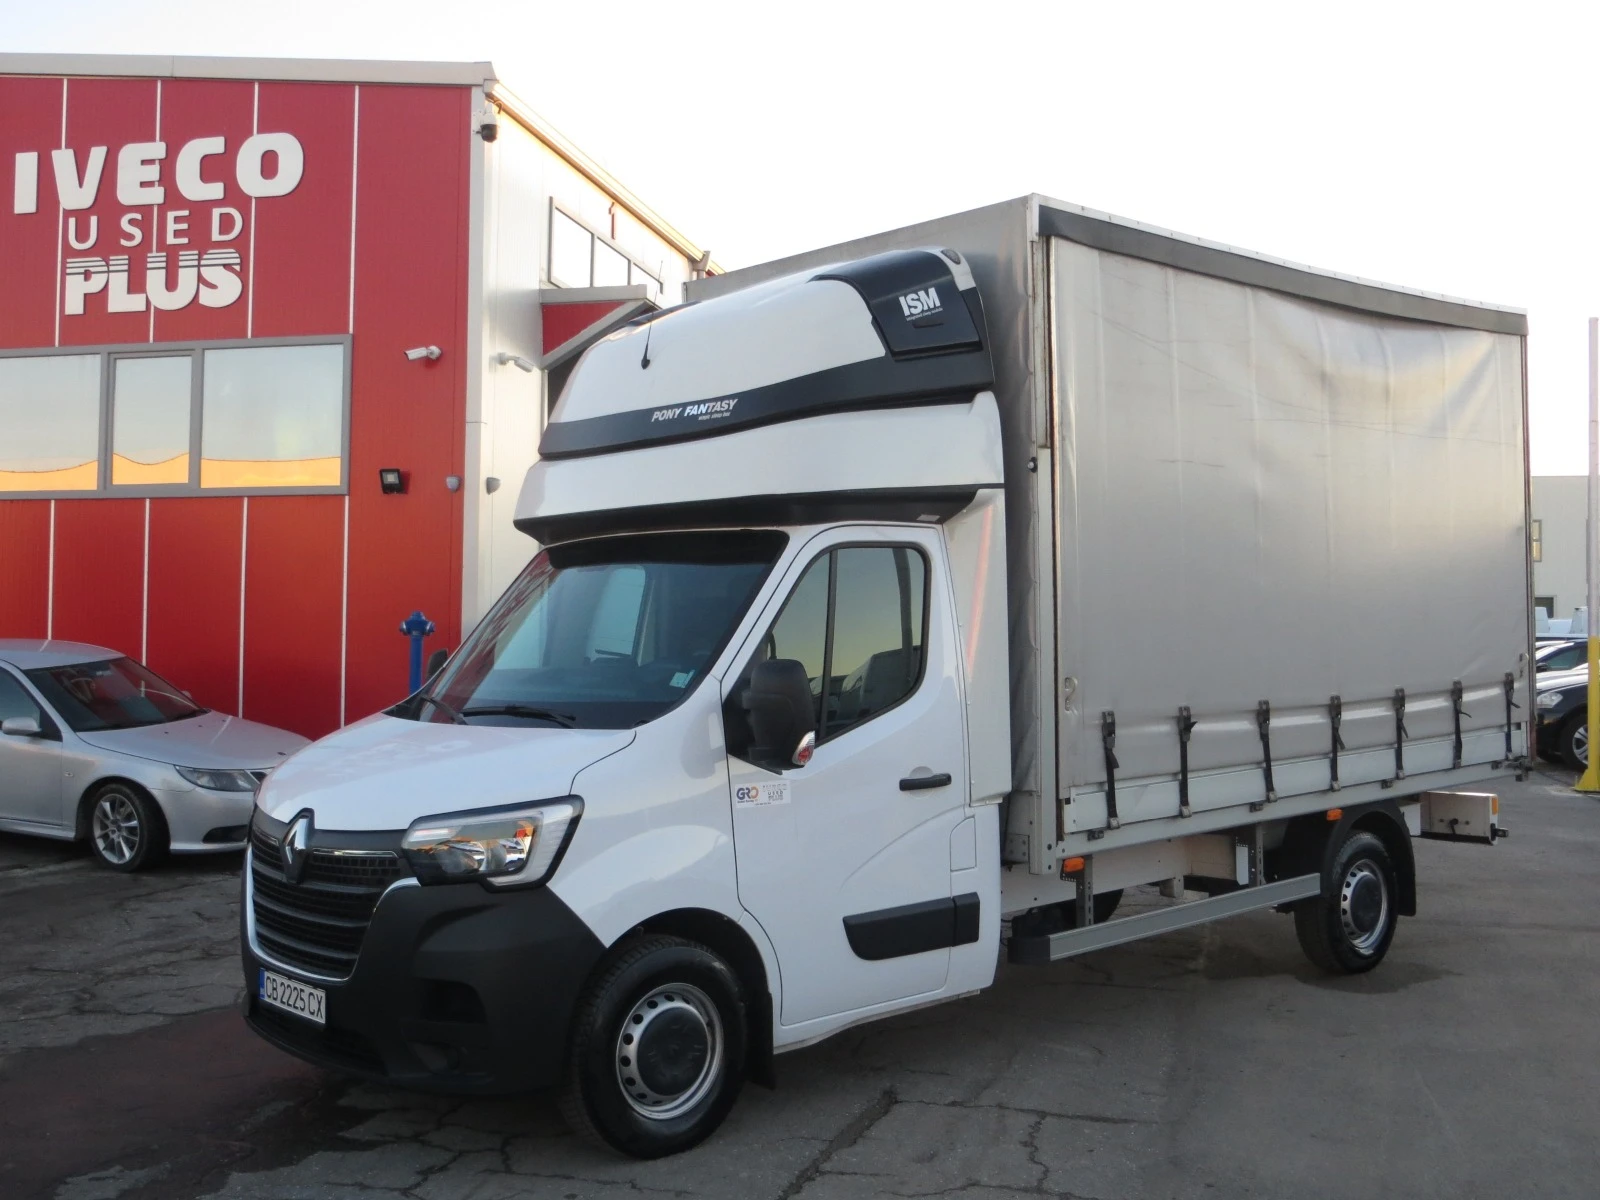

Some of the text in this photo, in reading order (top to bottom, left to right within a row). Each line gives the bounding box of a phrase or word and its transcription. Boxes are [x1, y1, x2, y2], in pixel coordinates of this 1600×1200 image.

[14, 132, 304, 215] IVECO
[68, 207, 243, 250] USED
[64, 248, 243, 315] PLUS
[899, 287, 941, 317] ISM
[651, 407, 683, 422] PONY
[684, 399, 738, 417] FANTASY
[736, 786, 759, 800] GRO
[265, 976, 323, 1019] CB 2225 CX
